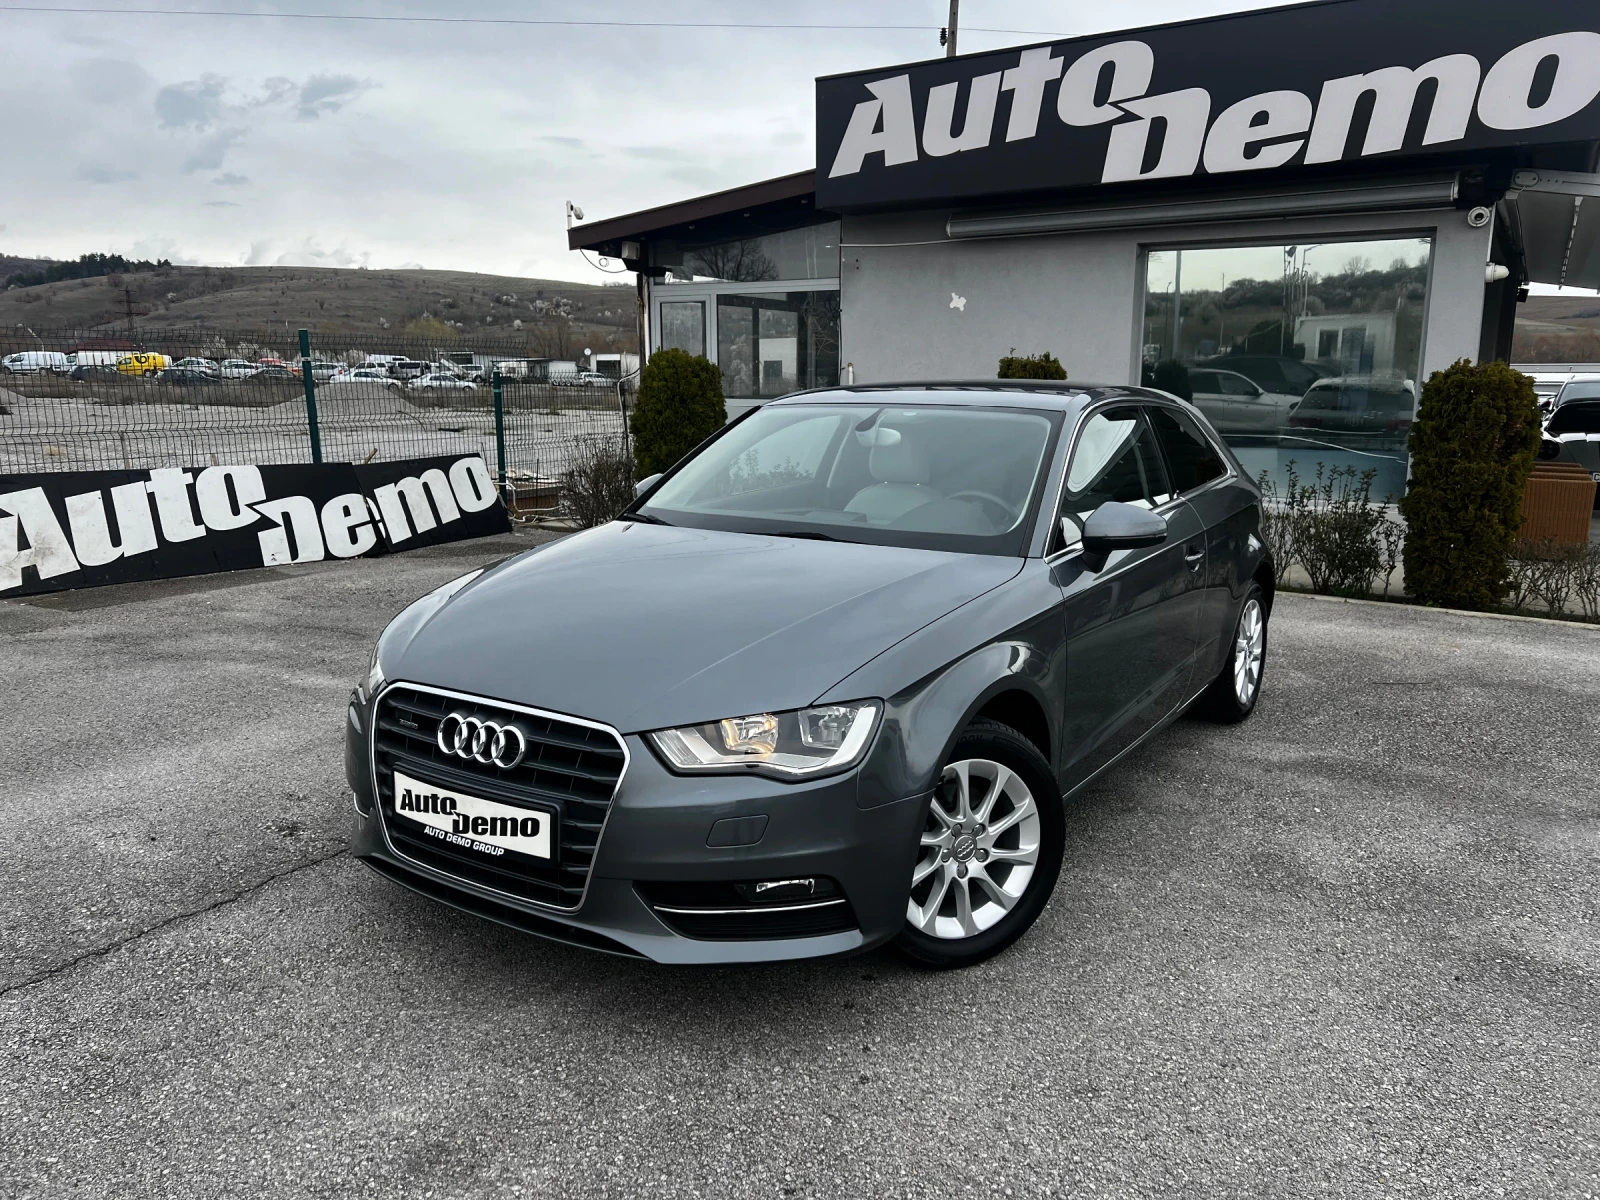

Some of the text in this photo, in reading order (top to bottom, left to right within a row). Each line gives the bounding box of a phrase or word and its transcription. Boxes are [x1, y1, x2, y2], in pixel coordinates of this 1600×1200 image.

[829, 32, 1600, 183] Auto Demo
[0, 457, 499, 591] Auto Demo
[400, 788, 540, 838] Auto Demo
[424, 825, 505, 857] AUTO DEMO GROUP
